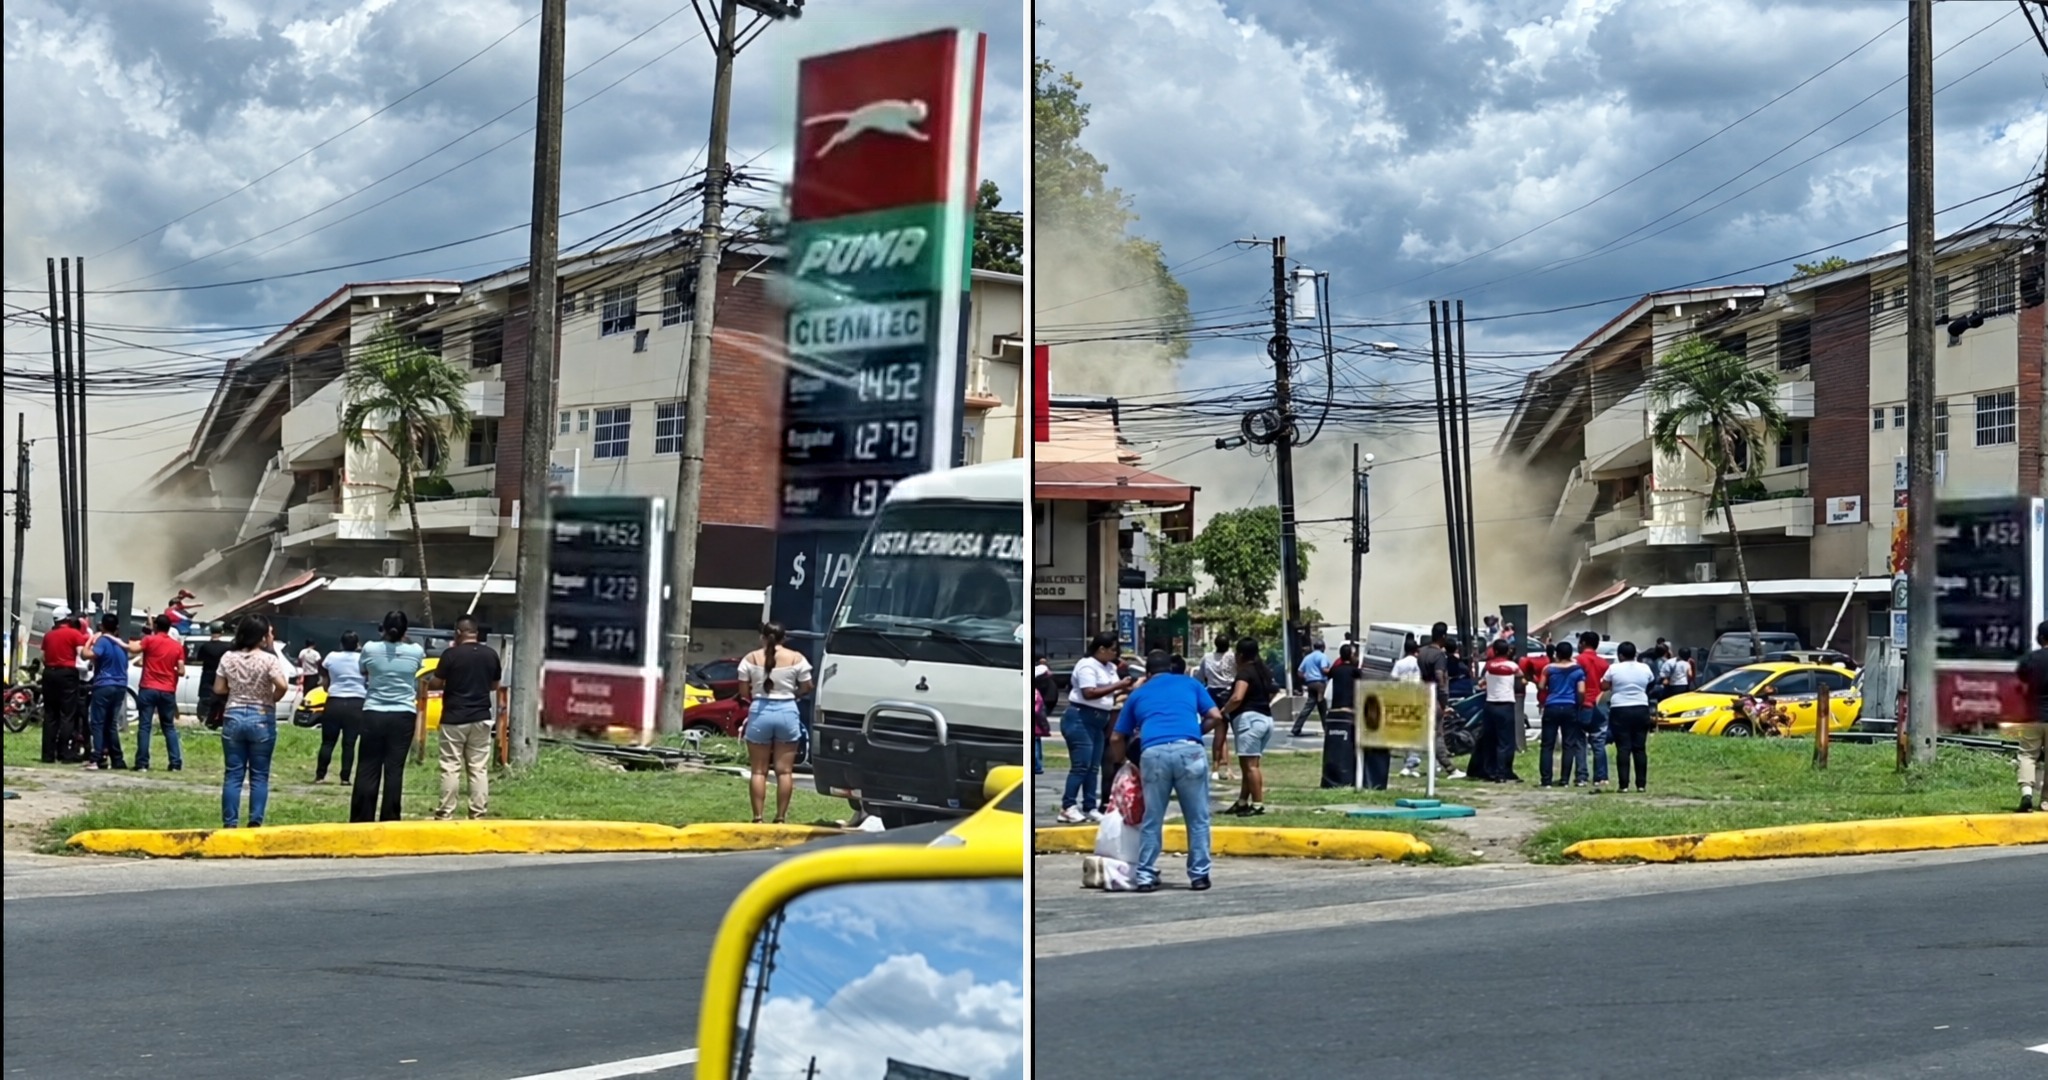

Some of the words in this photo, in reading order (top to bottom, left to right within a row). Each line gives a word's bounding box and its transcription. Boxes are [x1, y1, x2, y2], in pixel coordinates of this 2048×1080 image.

[796, 227, 927, 276] PUMA
[795, 308, 920, 345] CLEANTEC
[907, 531, 984, 557] HERMOSA
